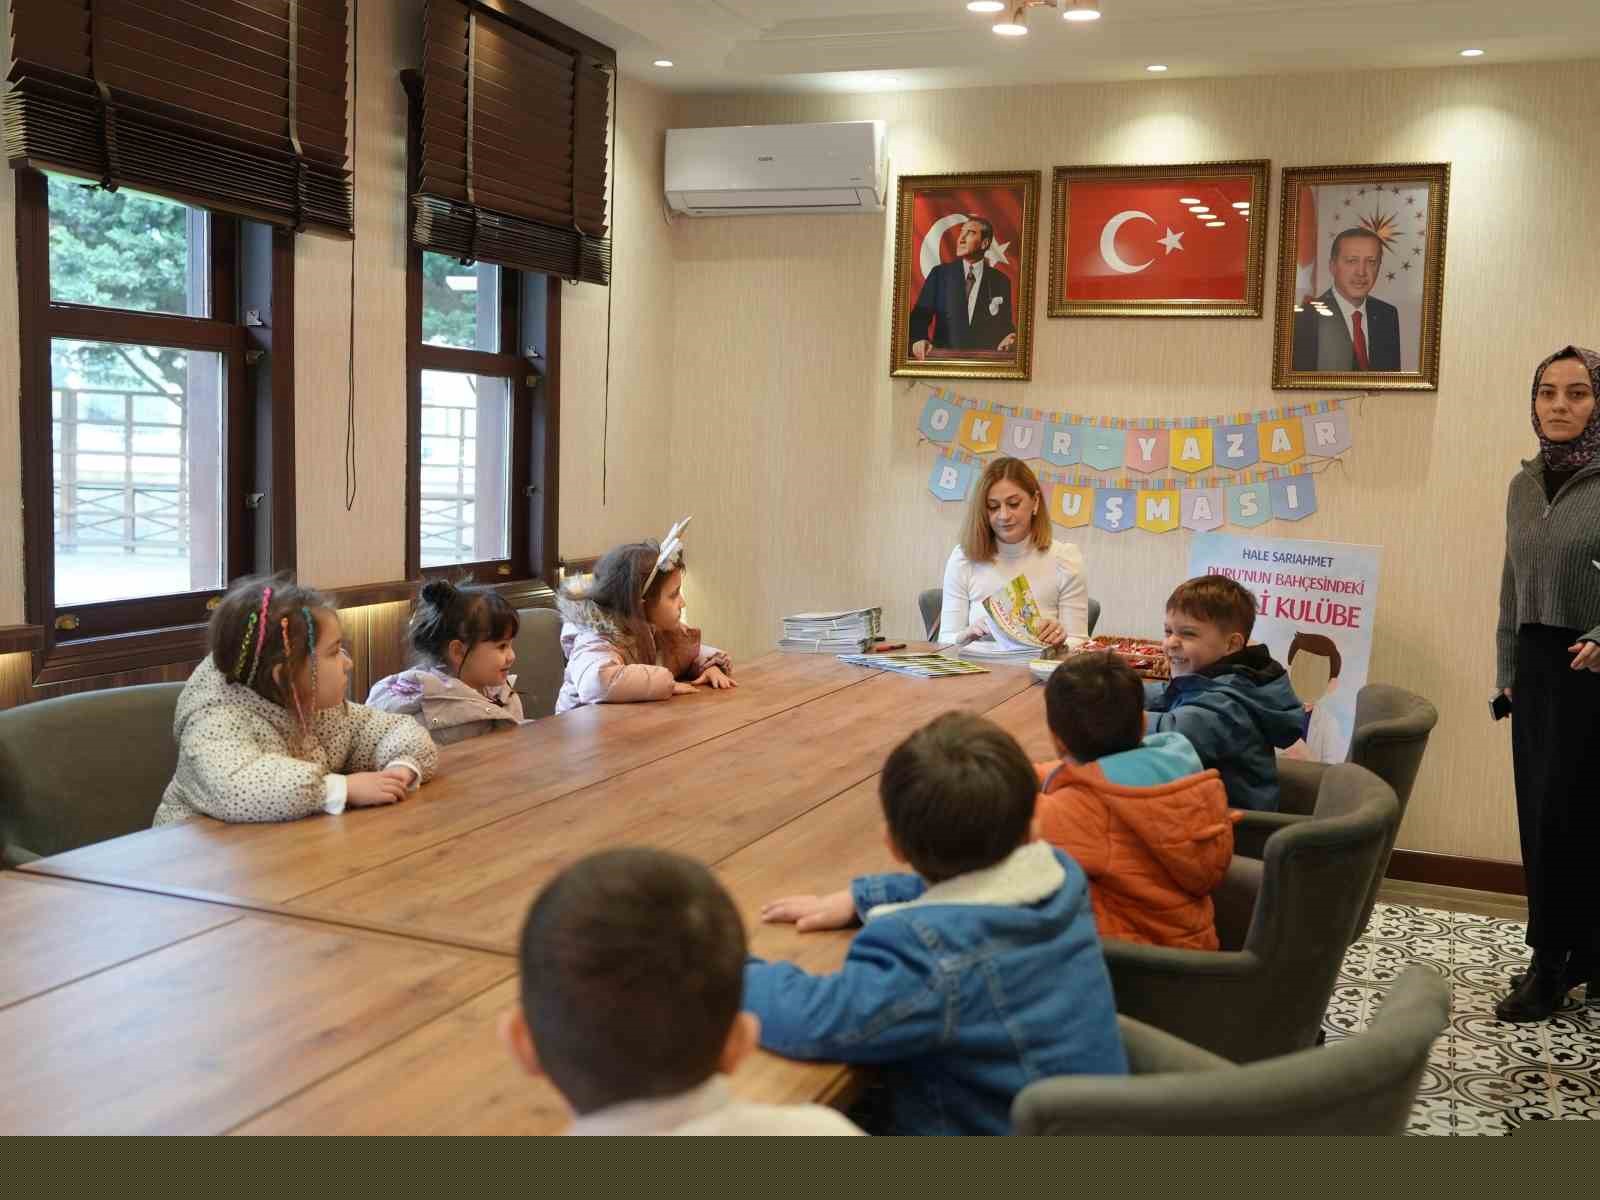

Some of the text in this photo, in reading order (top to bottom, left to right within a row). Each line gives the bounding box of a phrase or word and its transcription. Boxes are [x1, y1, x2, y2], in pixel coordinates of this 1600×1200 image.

[939, 466, 1299, 529] BUŞMASI
[1243, 549, 1335, 568] HALE SARIAHMET
[1275, 573, 1364, 595] BAHÇESİNDEKİ
[1275, 596, 1361, 628] KULÜBE
